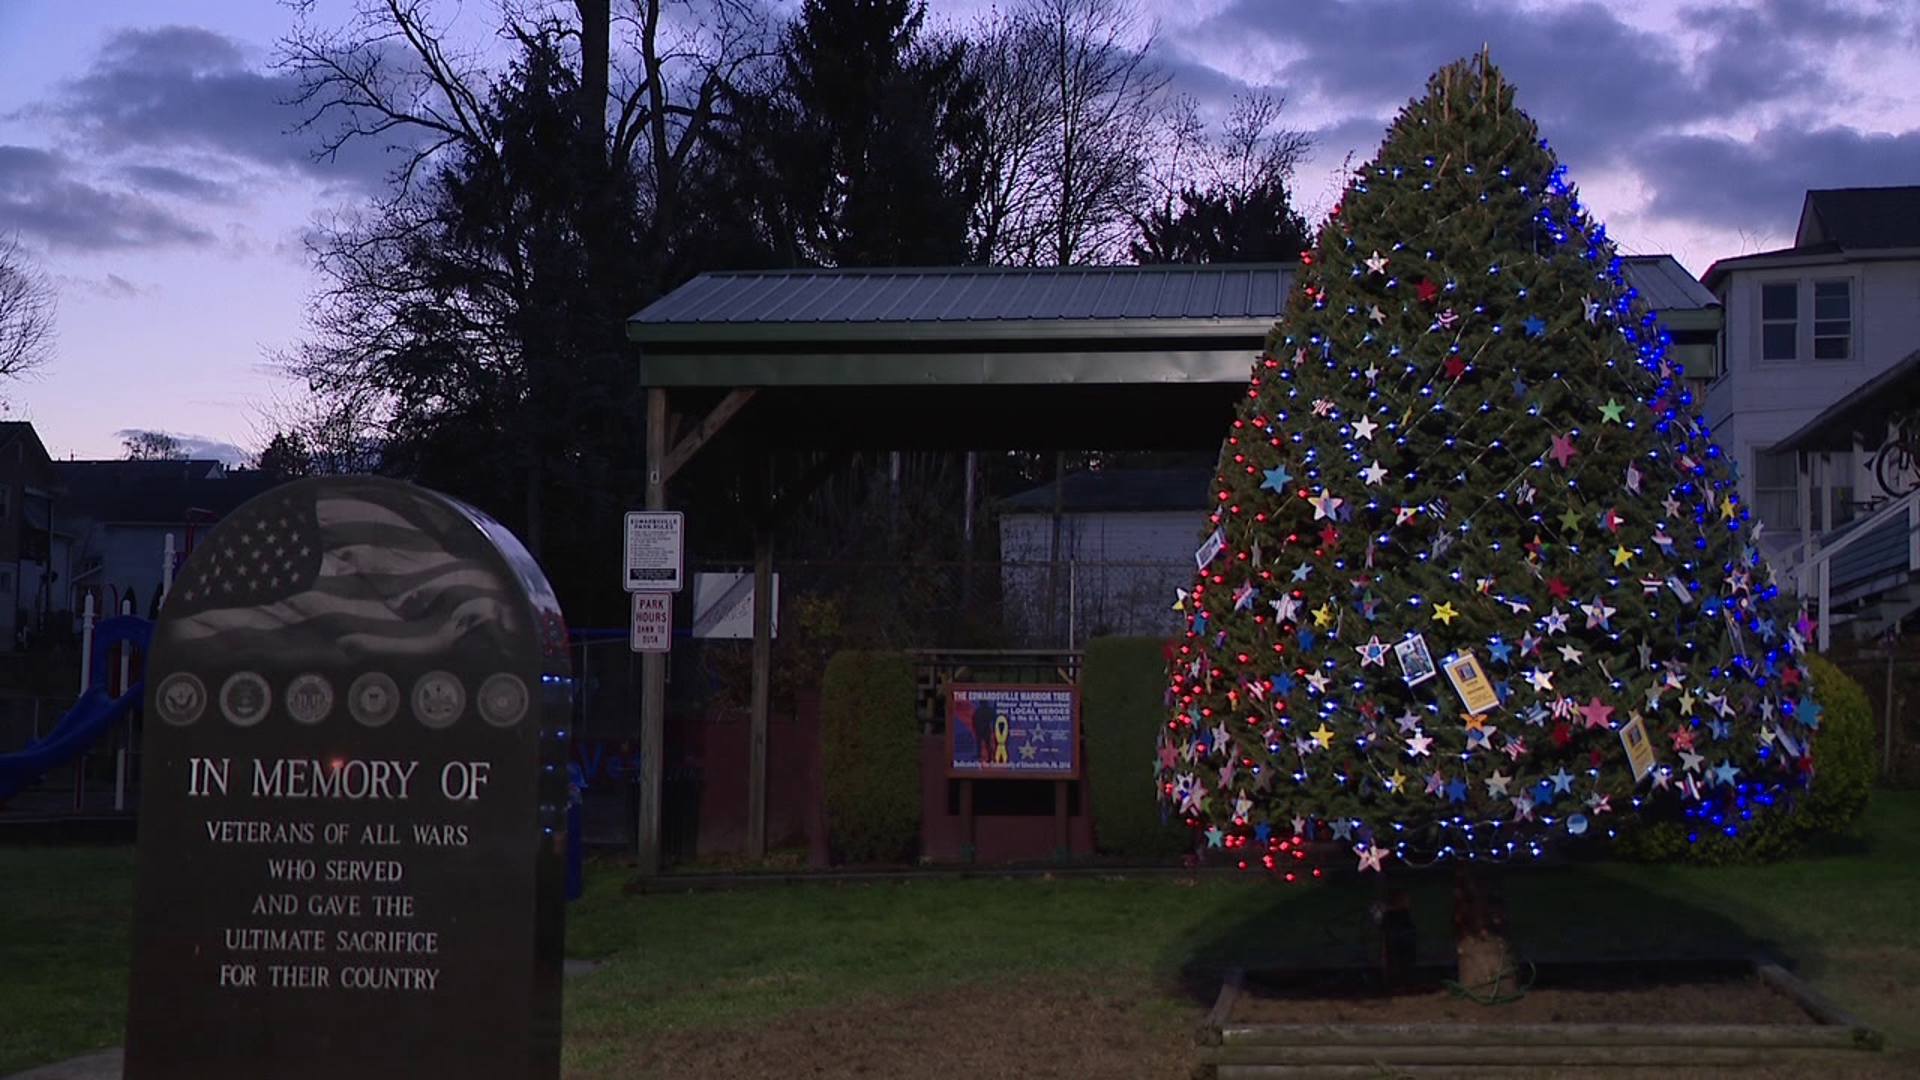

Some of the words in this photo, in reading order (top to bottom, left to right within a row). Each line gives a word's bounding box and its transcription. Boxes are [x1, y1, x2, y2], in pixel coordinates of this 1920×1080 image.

[639, 599, 664, 610] PARK
[636, 611, 667, 623] HOURS
[637, 624, 654, 634] DAWN
[658, 624, 665, 634] TO
[953, 691, 966, 701] THE
[968, 691, 1019, 701] EDWARDSVILLE
[1020, 691, 1051, 702] WARRIOR
[1053, 692, 1071, 702] TREE
[1010, 707, 1036, 715] LOCAL
[1038, 707, 1071, 715] HEROES
[189, 759, 230, 796] IN
[252, 759, 419, 798] MEMORY
[441, 761, 491, 800] OF
[206, 820, 314, 844] VETERANS
[324, 823, 350, 844] OF
[360, 824, 401, 845] ALL
[413, 824, 469, 846] WARS
[268, 859, 316, 881] WHO
[325, 860, 403, 882] SERVED
[252, 894, 299, 916] AND
[308, 895, 361, 916] GAVE
[372, 895, 414, 917] THE
[225, 928, 325, 951] ULTIMATE
[336, 930, 438, 953] SACRIFICE
[220, 964, 257, 987] FOR
[268, 965, 330, 988] THEIR
[340, 966, 440, 990] COUNTRY
